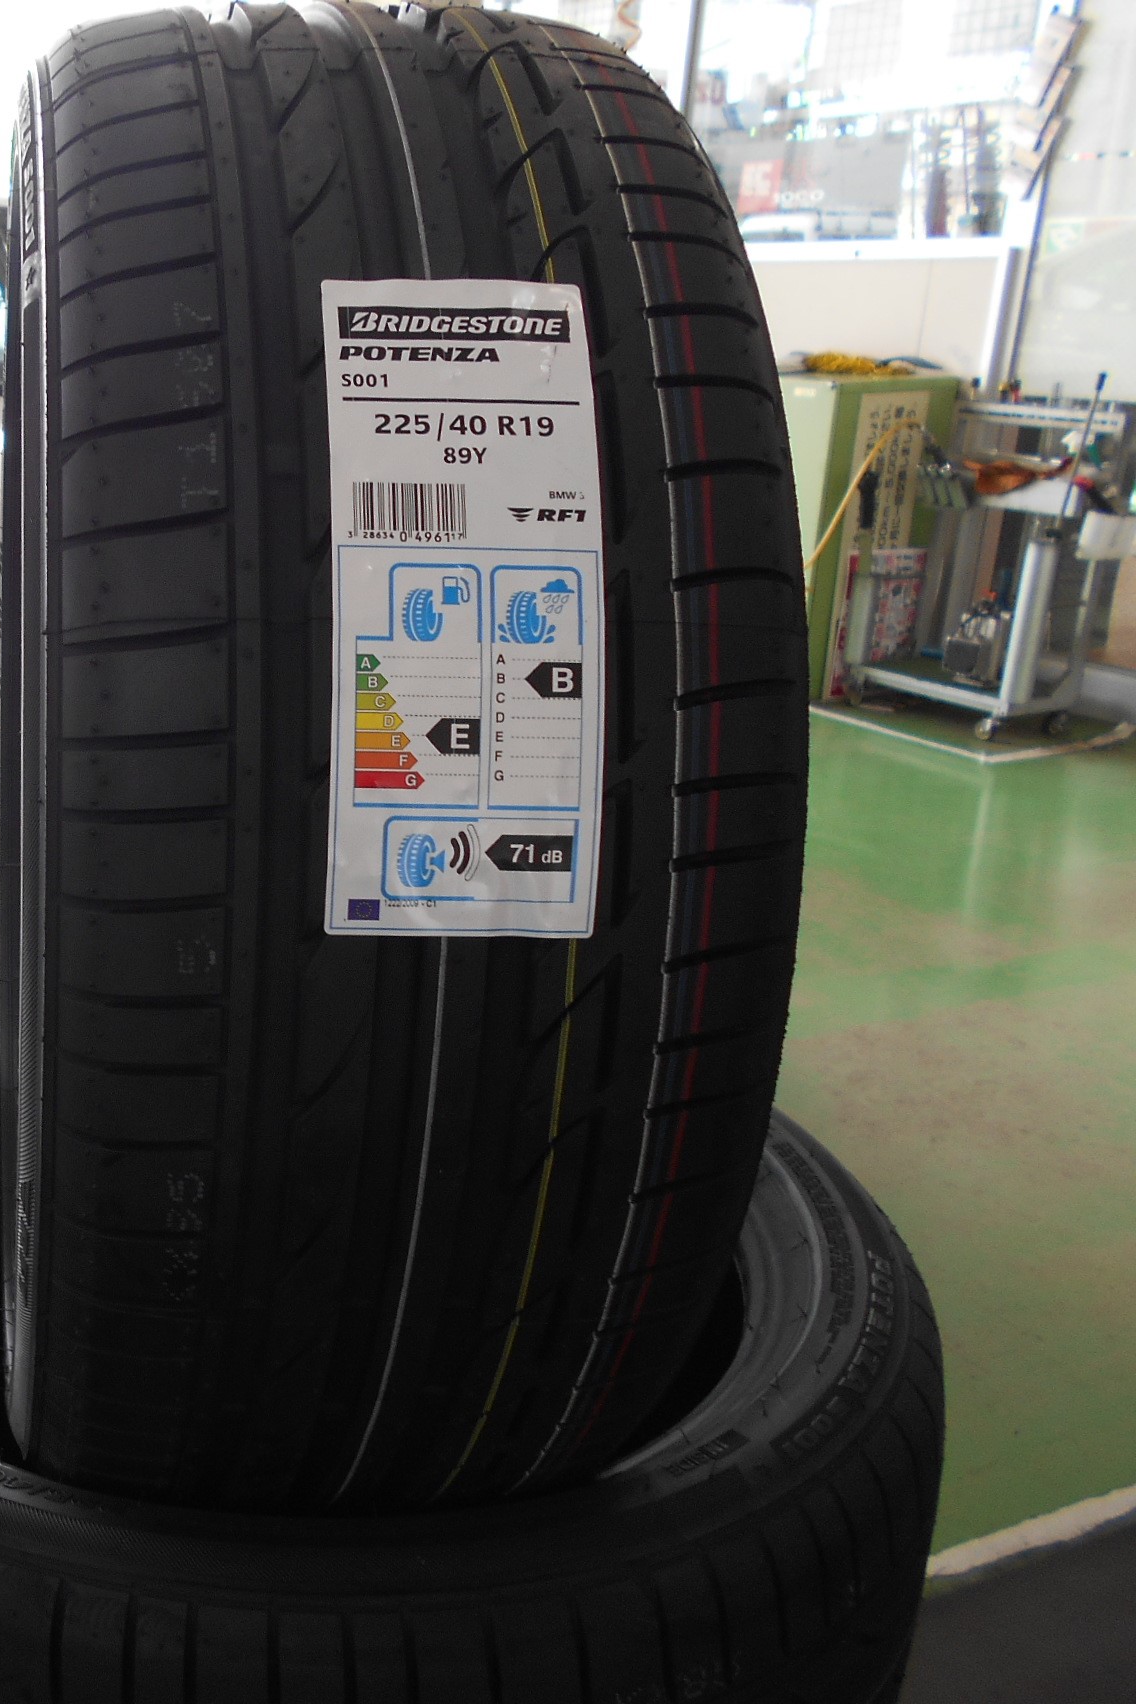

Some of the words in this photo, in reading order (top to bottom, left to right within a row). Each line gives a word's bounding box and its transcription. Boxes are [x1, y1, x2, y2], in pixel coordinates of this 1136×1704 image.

[23, 158, 36, 251] S001
[350, 311, 563, 335] BRIDGESTONE
[339, 345, 500, 362] POTENZA
[341, 373, 389, 387] S001
[374, 413, 487, 442] 225/40
[498, 416, 554, 437] R19
[443, 447, 487, 464] 89Y
[549, 490, 577, 500] BMW
[360, 658, 371, 669] A
[496, 654, 506, 665] A
[368, 677, 378, 688] B
[497, 673, 506, 684] B
[552, 667, 574, 693] B
[375, 696, 386, 708] C
[495, 693, 506, 704] C
[384, 716, 394, 728] D
[496, 713, 505, 723] D
[391, 735, 401, 747] E
[450, 724, 470, 749] E
[495, 732, 504, 742] E
[399, 755, 408, 767] F
[495, 751, 503, 762] F
[405, 774, 417, 787] G
[494, 770, 505, 782] G
[510, 844, 534, 864] 71
[541, 850, 563, 864] dB
